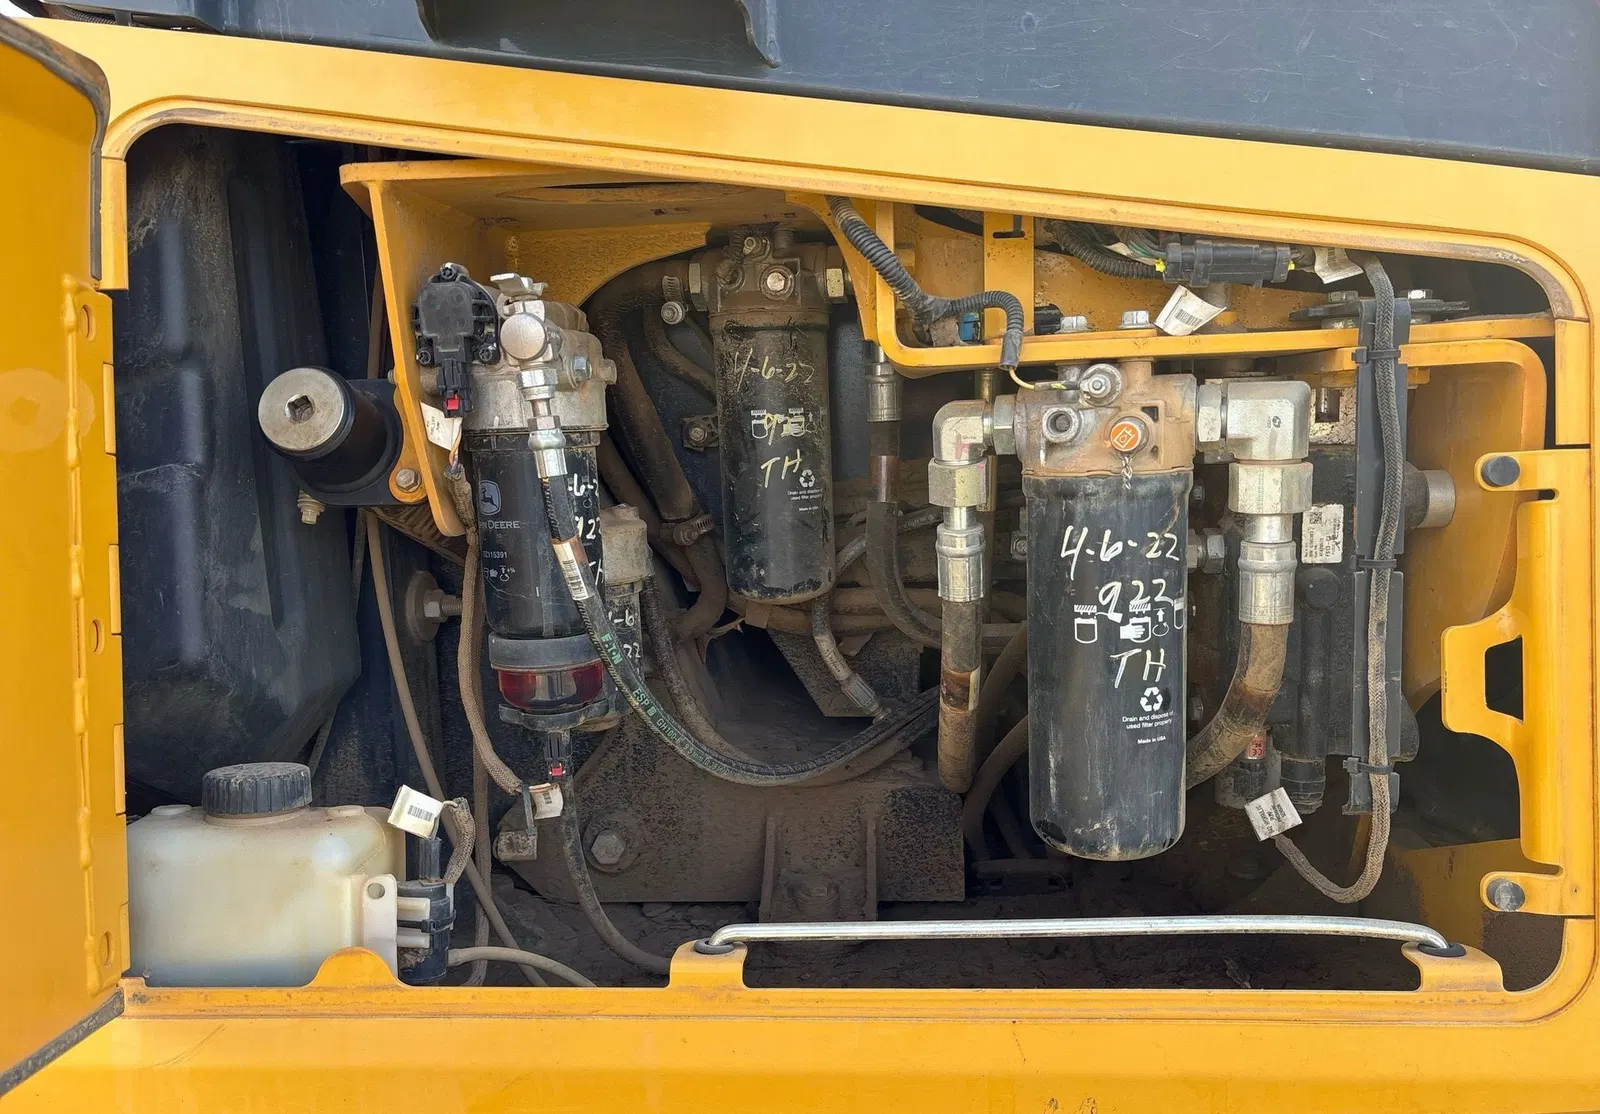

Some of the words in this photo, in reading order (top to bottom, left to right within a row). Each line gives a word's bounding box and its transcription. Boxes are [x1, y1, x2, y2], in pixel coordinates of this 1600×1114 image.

[761, 449, 803, 489] TH
[487, 520, 521, 530] DEERE
[1061, 525, 1180, 580] 4-6-22
[1098, 579, 1174, 617] 922
[1110, 648, 1167, 689] TH
[632, 687, 650, 706] ESP
[1126, 722, 1141, 730] used
